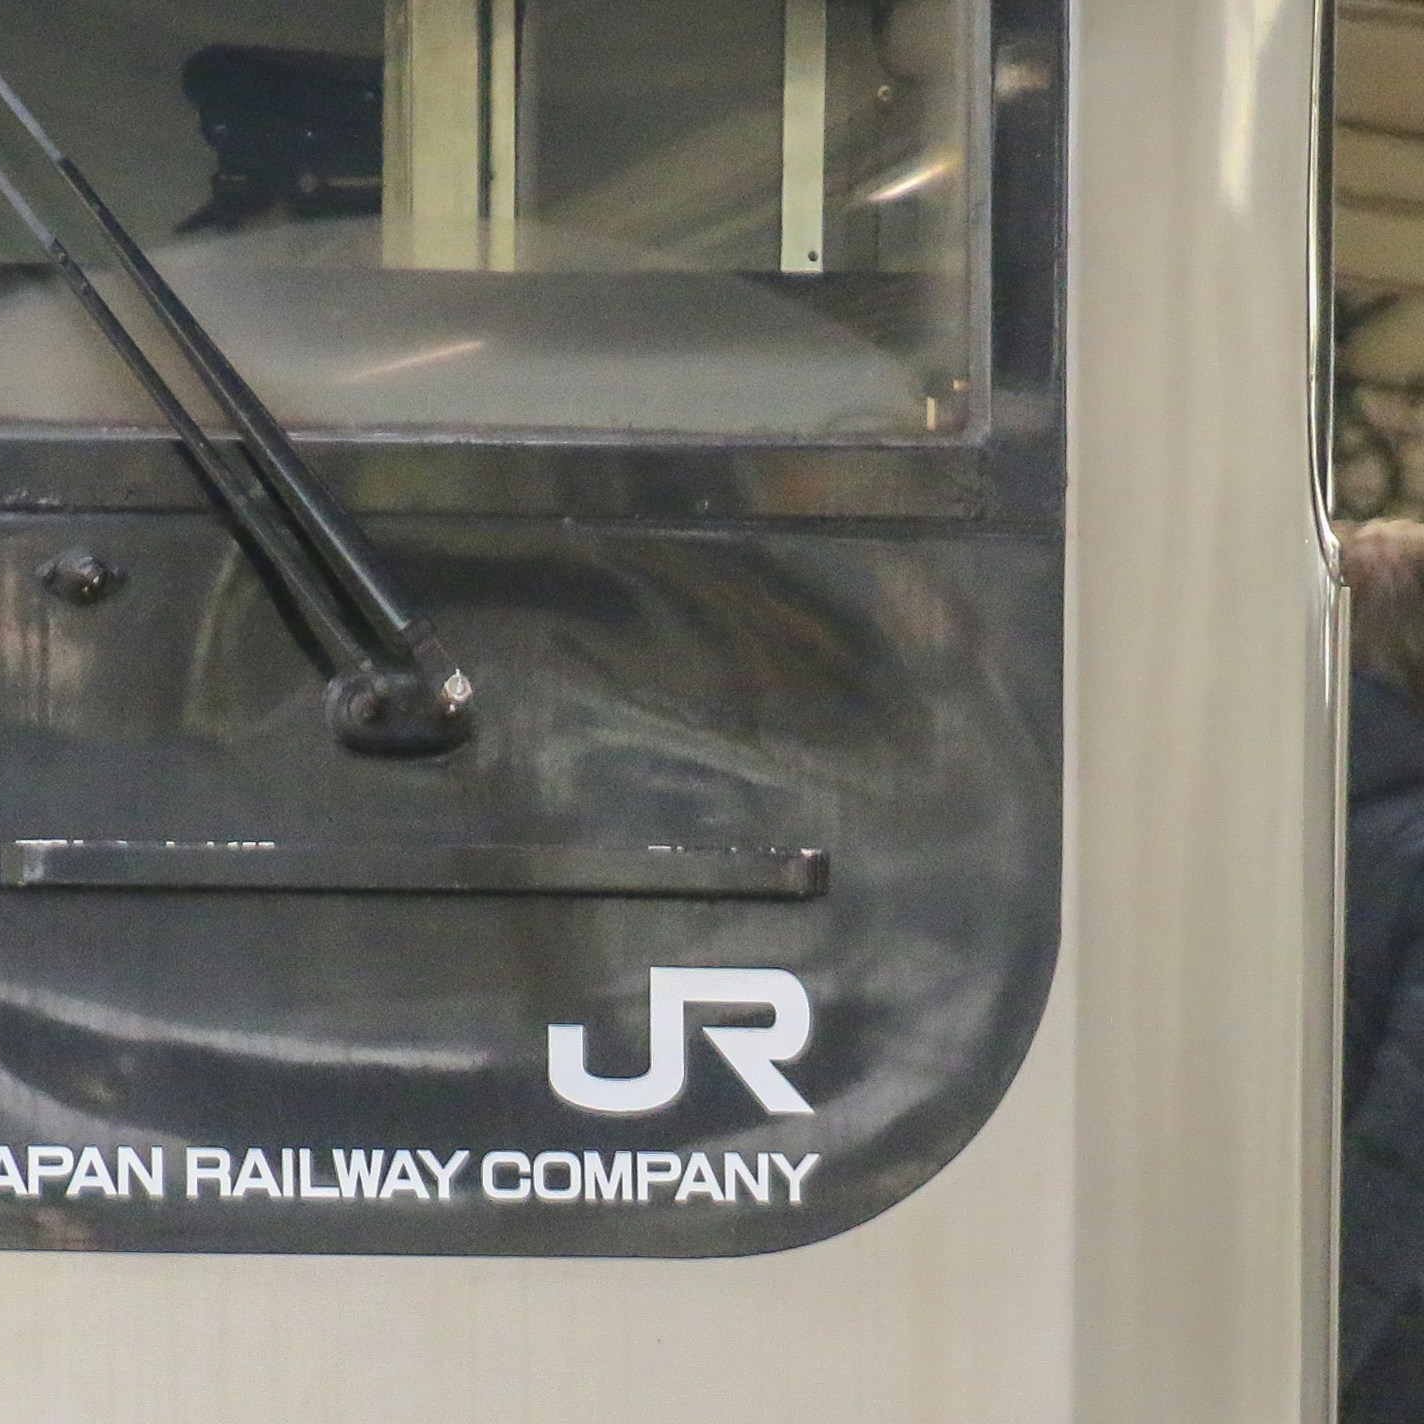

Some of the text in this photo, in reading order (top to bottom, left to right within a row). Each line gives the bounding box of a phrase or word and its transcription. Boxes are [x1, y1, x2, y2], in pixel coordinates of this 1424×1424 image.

[546, 966, 816, 1117] JR
[186, 1146, 471, 1201] RAILWAY
[482, 1149, 821, 1204] COMPANY
